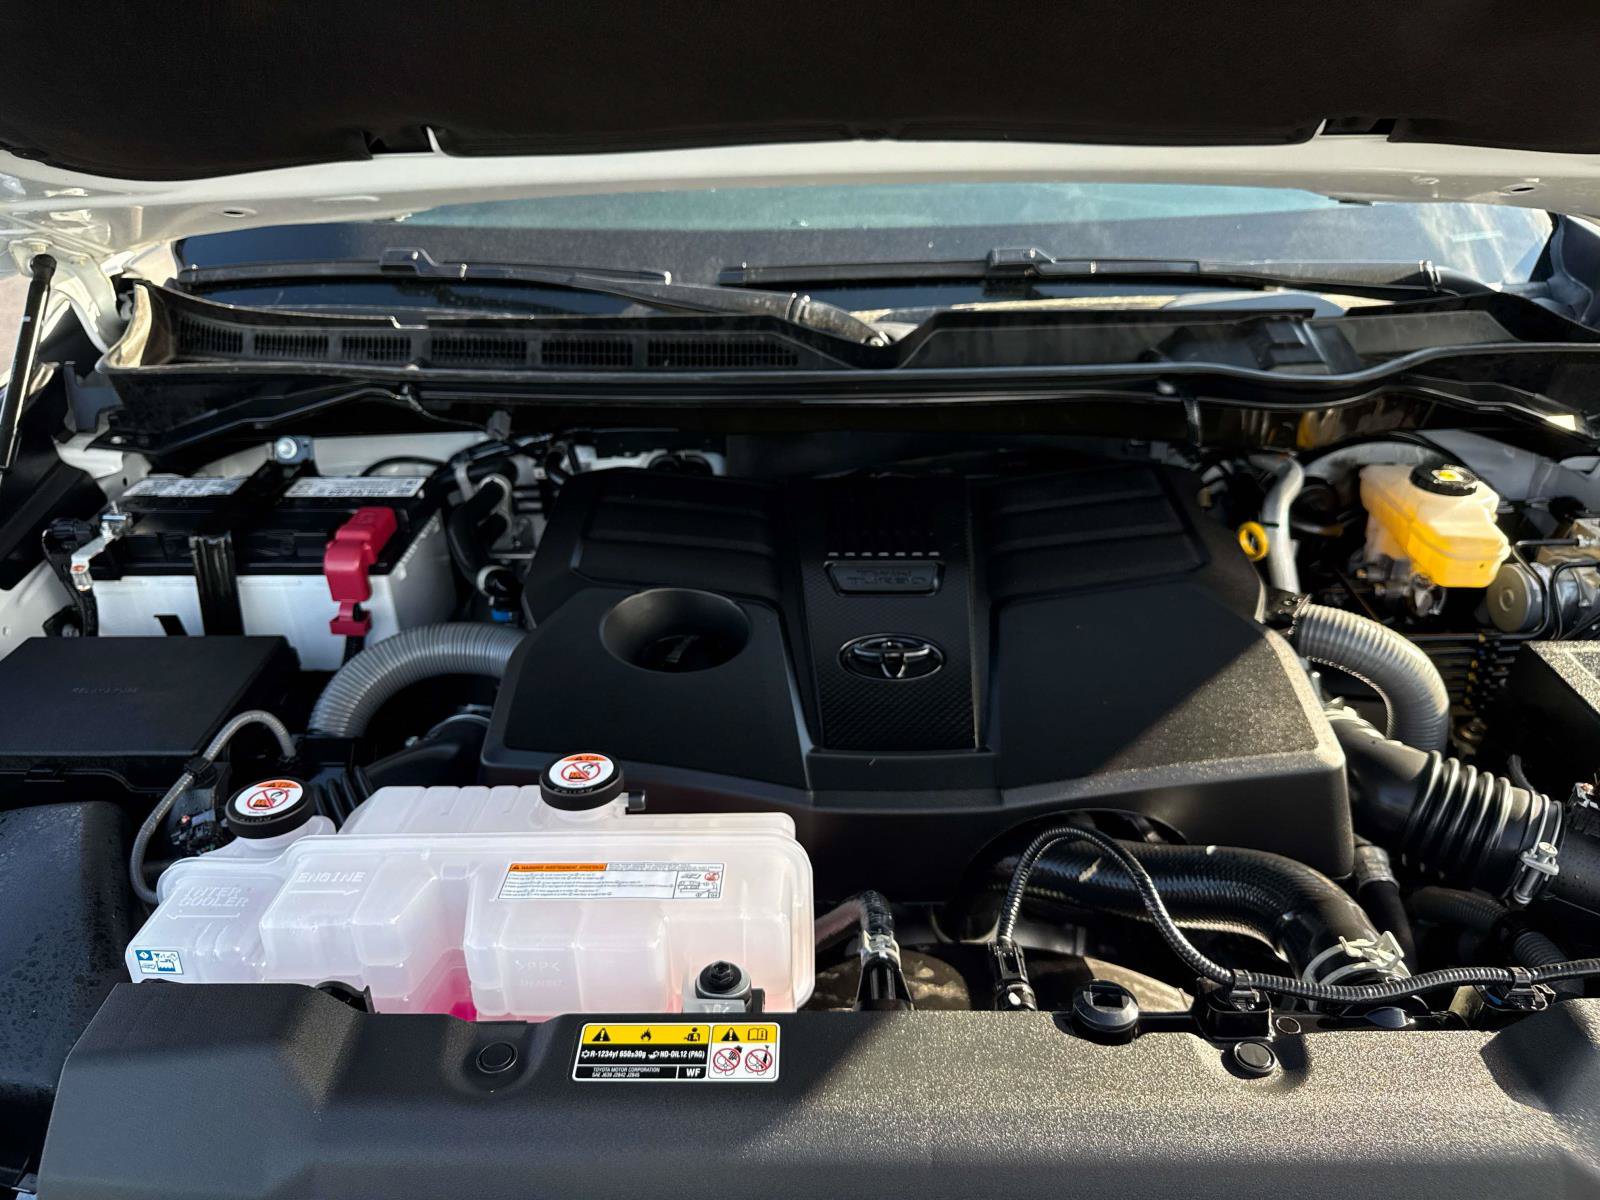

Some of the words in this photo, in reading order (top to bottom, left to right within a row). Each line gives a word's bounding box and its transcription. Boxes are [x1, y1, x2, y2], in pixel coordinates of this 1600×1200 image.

[298, 871, 367, 883] ENGINE
[184, 887, 242, 897] INTER
[178, 897, 249, 907] COOLER
[590, 1050, 618, 1060] R-1234yf
[688, 1050, 705, 1060] (PAG)
[686, 1068, 701, 1077] WF
